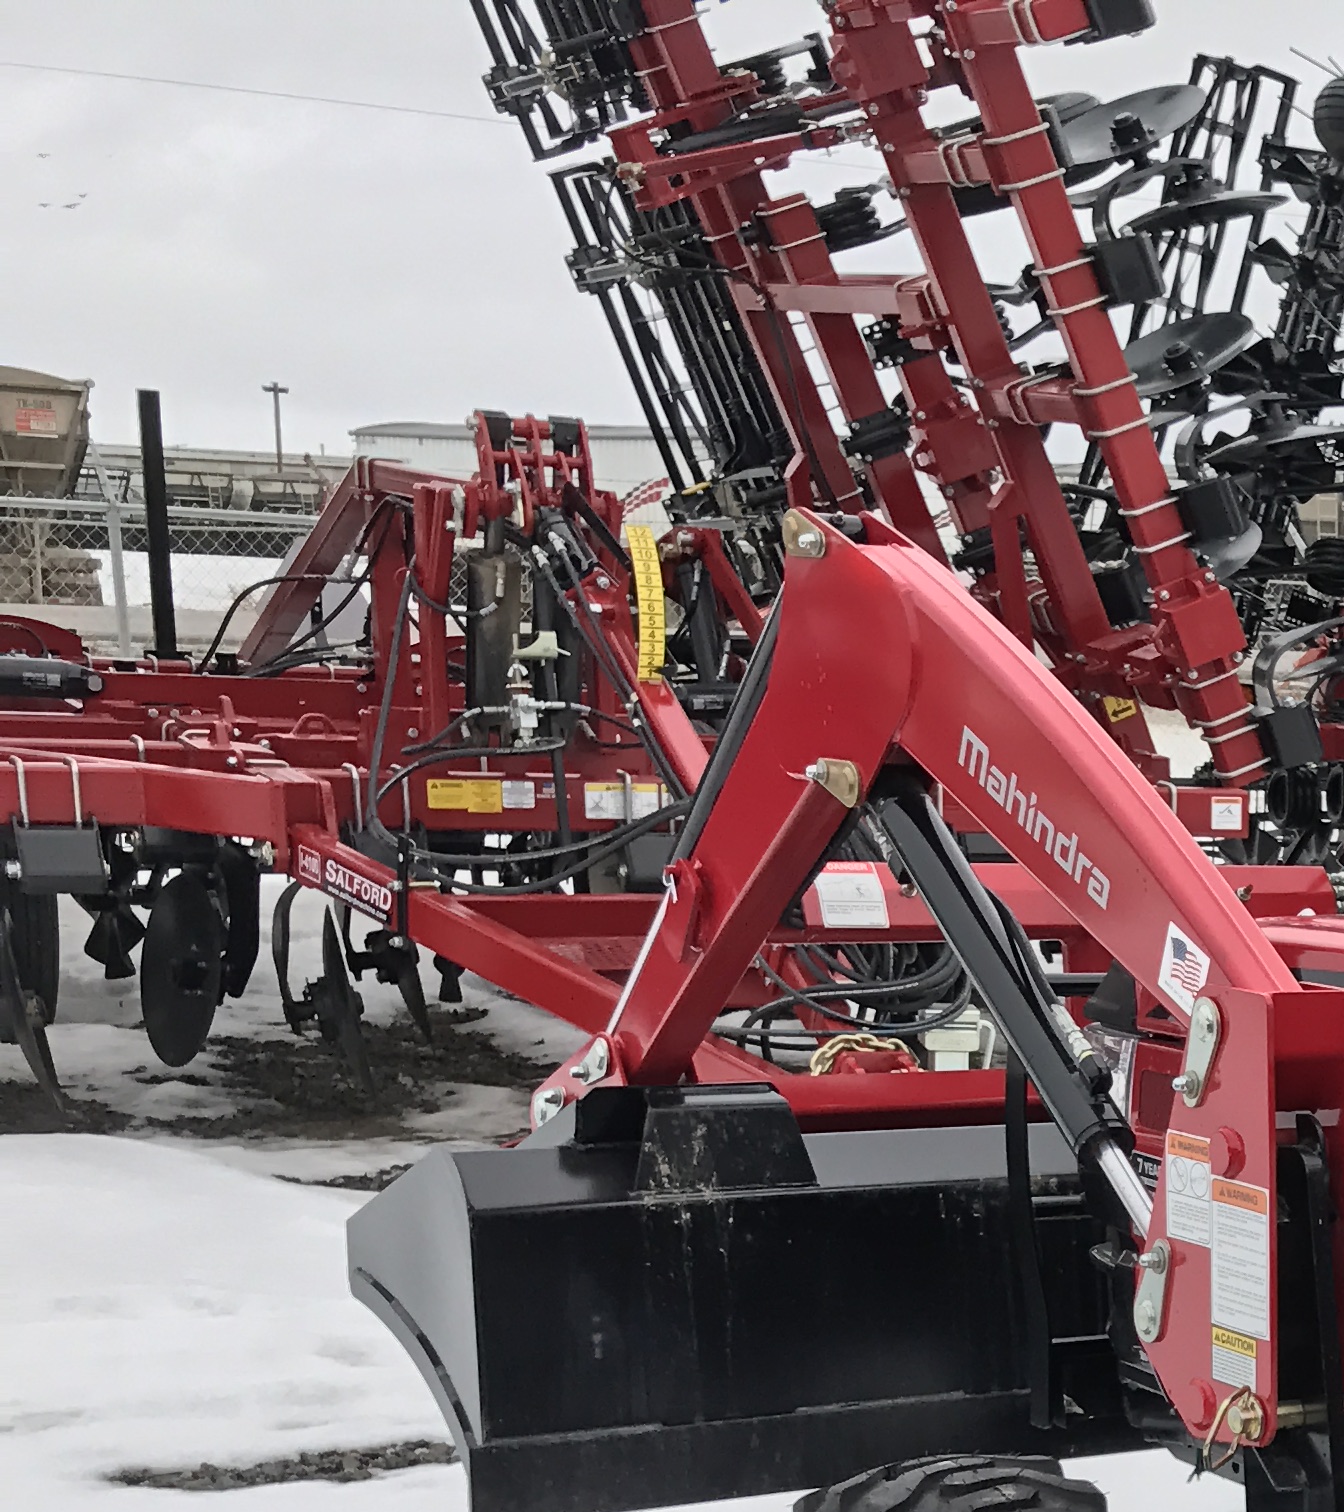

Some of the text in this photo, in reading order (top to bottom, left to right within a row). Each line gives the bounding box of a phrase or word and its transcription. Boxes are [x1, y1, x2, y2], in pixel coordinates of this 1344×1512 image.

[632, 528, 646, 537] 12
[635, 538, 649, 547] 11
[638, 550, 653, 560] 10
[643, 562, 651, 572] 9
[645, 575, 653, 585] 8
[647, 588, 655, 598] 7
[647, 602, 655, 613] 6
[648, 615, 656, 626] 5
[648, 629, 656, 640] 4
[648, 643, 656, 653] 3
[647, 656, 655, 666] 2
[826, 862, 868, 871] DANGER
[325, 859, 392, 911] SALFORD
[1136, 1157, 1158, 1177] 7 YEA
[1220, 1331, 1255, 1354] CAUTION
